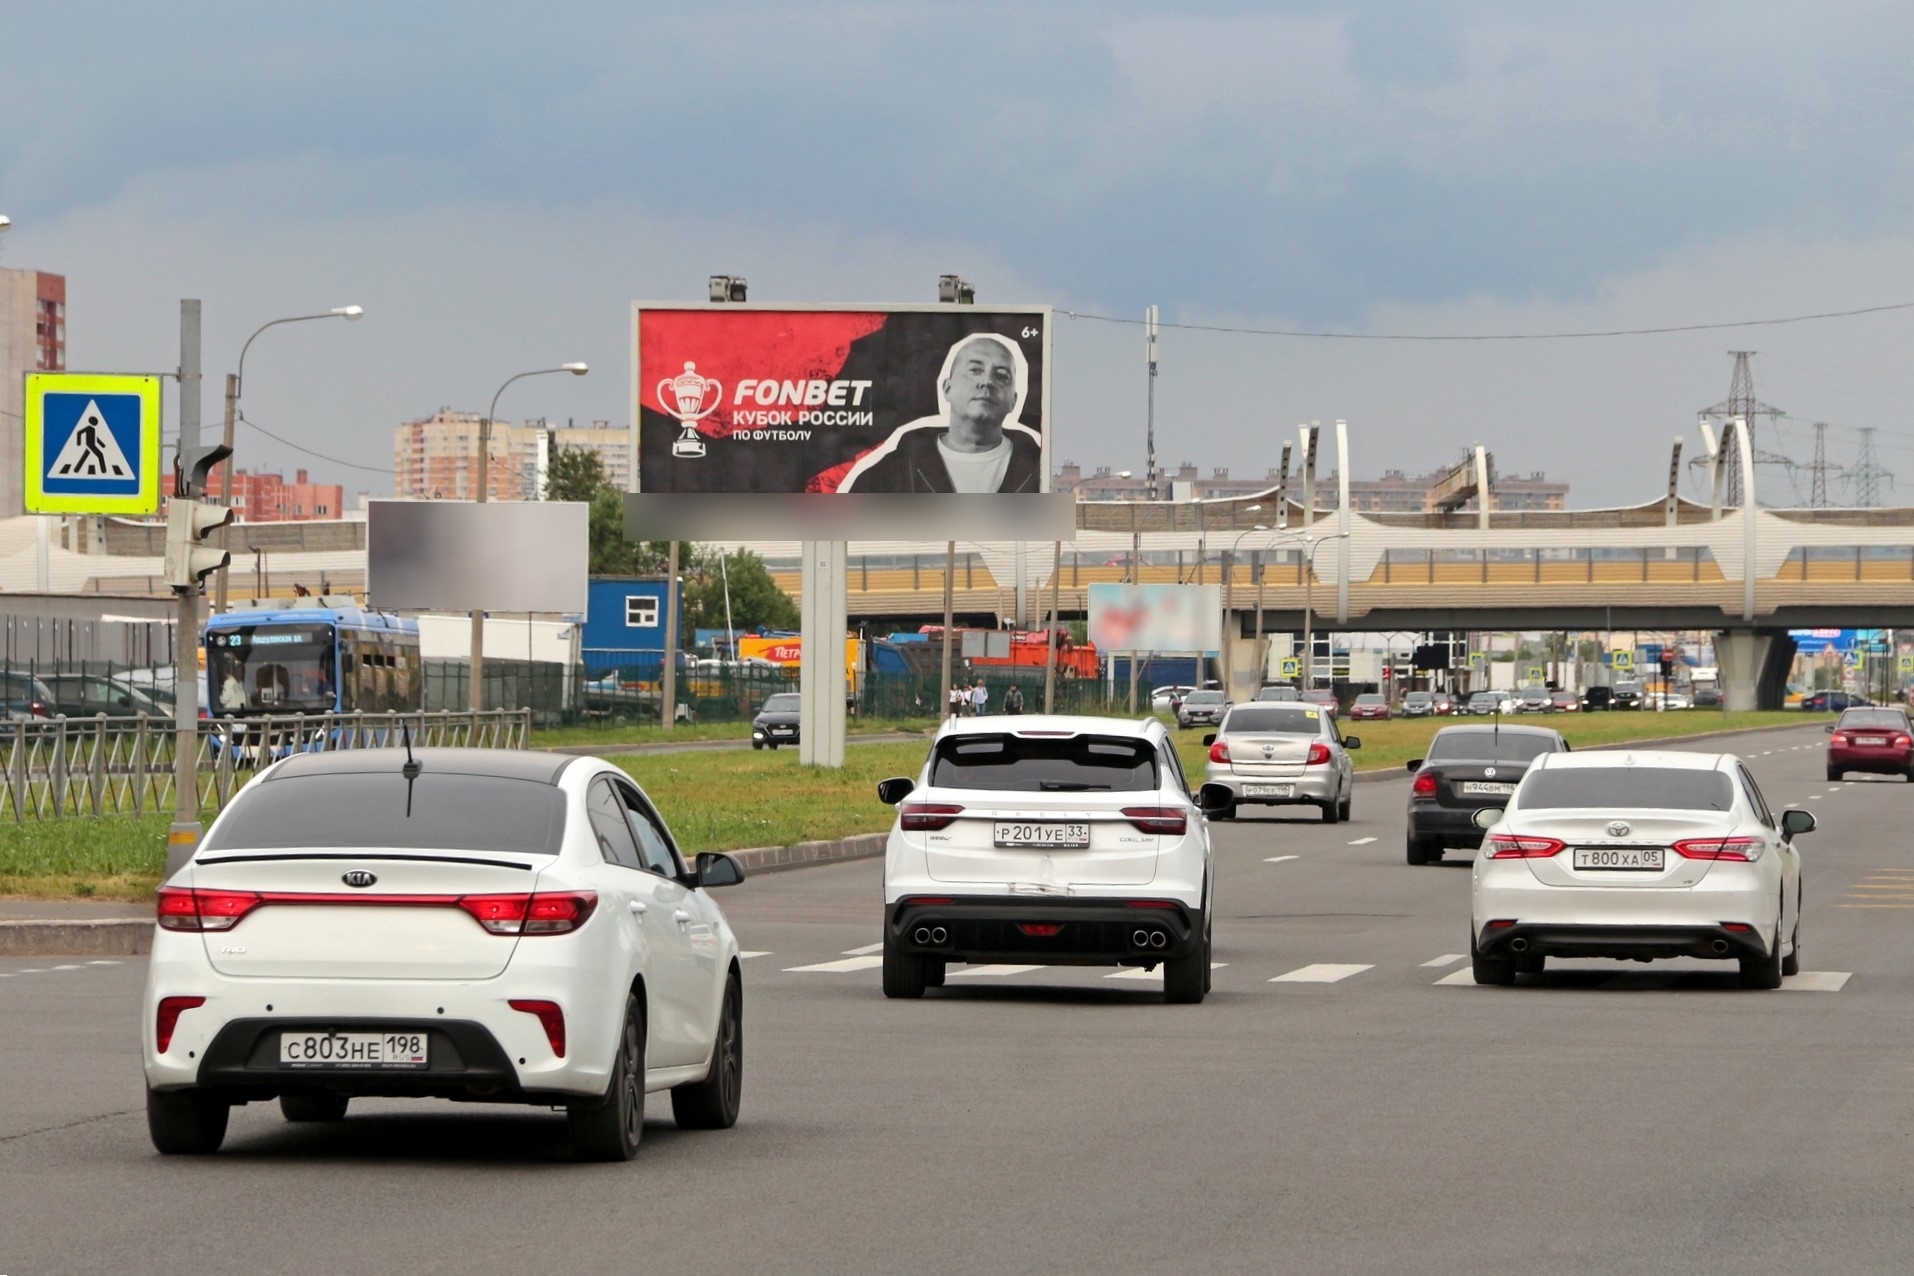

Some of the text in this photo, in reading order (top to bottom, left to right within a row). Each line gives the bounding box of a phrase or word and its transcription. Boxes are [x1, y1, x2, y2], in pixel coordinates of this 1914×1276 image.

[1021, 326, 1039, 338] 6+
[733, 379, 872, 406] FONBET
[733, 411, 873, 427] КУБОК РОССИИ
[733, 430, 812, 441] ПО ФУТБОЛУ
[229, 635, 242, 647] 23
[775, 646, 801, 659] ПЕТР
[1068, 826, 1083, 837] 33
[1643, 851, 1658, 862] 05
[347, 873, 372, 885] KIA
[386, 1036, 421, 1054] 198
